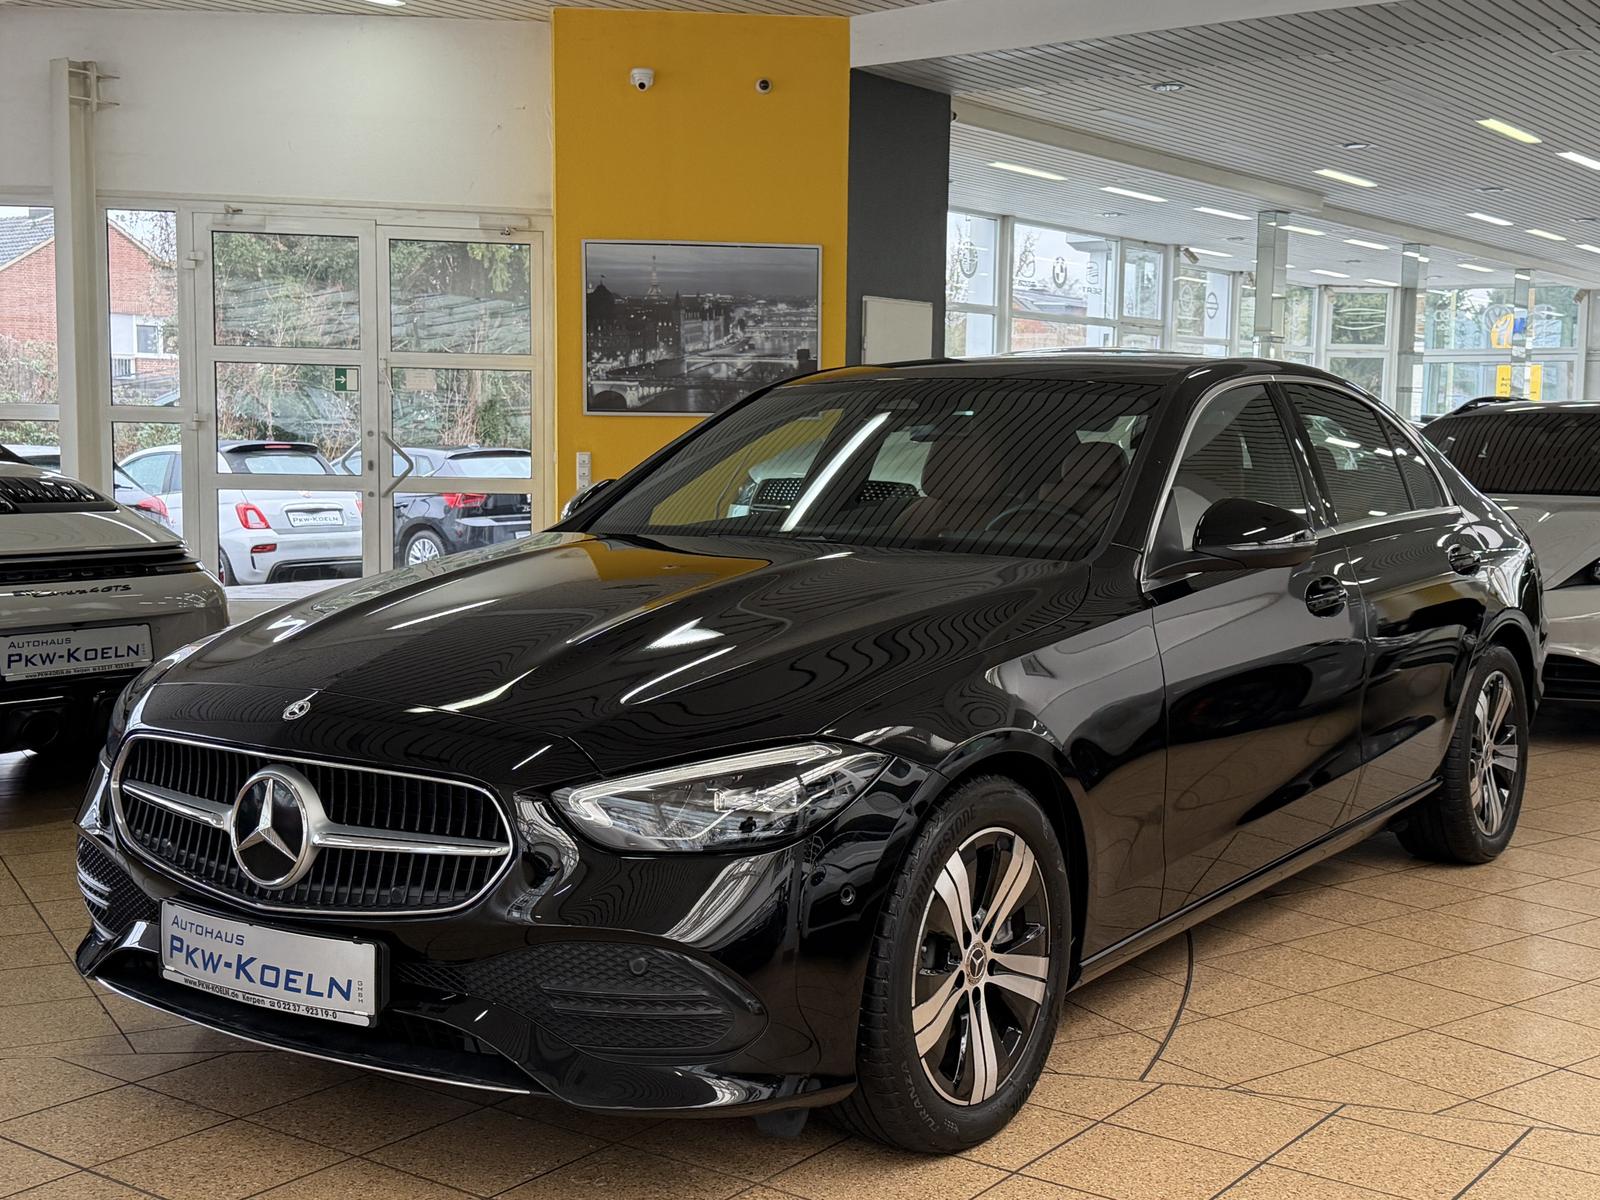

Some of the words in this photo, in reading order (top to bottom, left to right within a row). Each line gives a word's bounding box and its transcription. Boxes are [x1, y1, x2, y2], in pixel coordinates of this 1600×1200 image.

[101, 584, 132, 593] GTS
[8, 637, 72, 650] AUTOHAUS
[7, 643, 140, 669] PKW-KOELN
[171, 914, 245, 946] AUTOHAUS
[169, 934, 353, 1001] PKW-KOELN
[241, 993, 266, 1006] Kerpen
